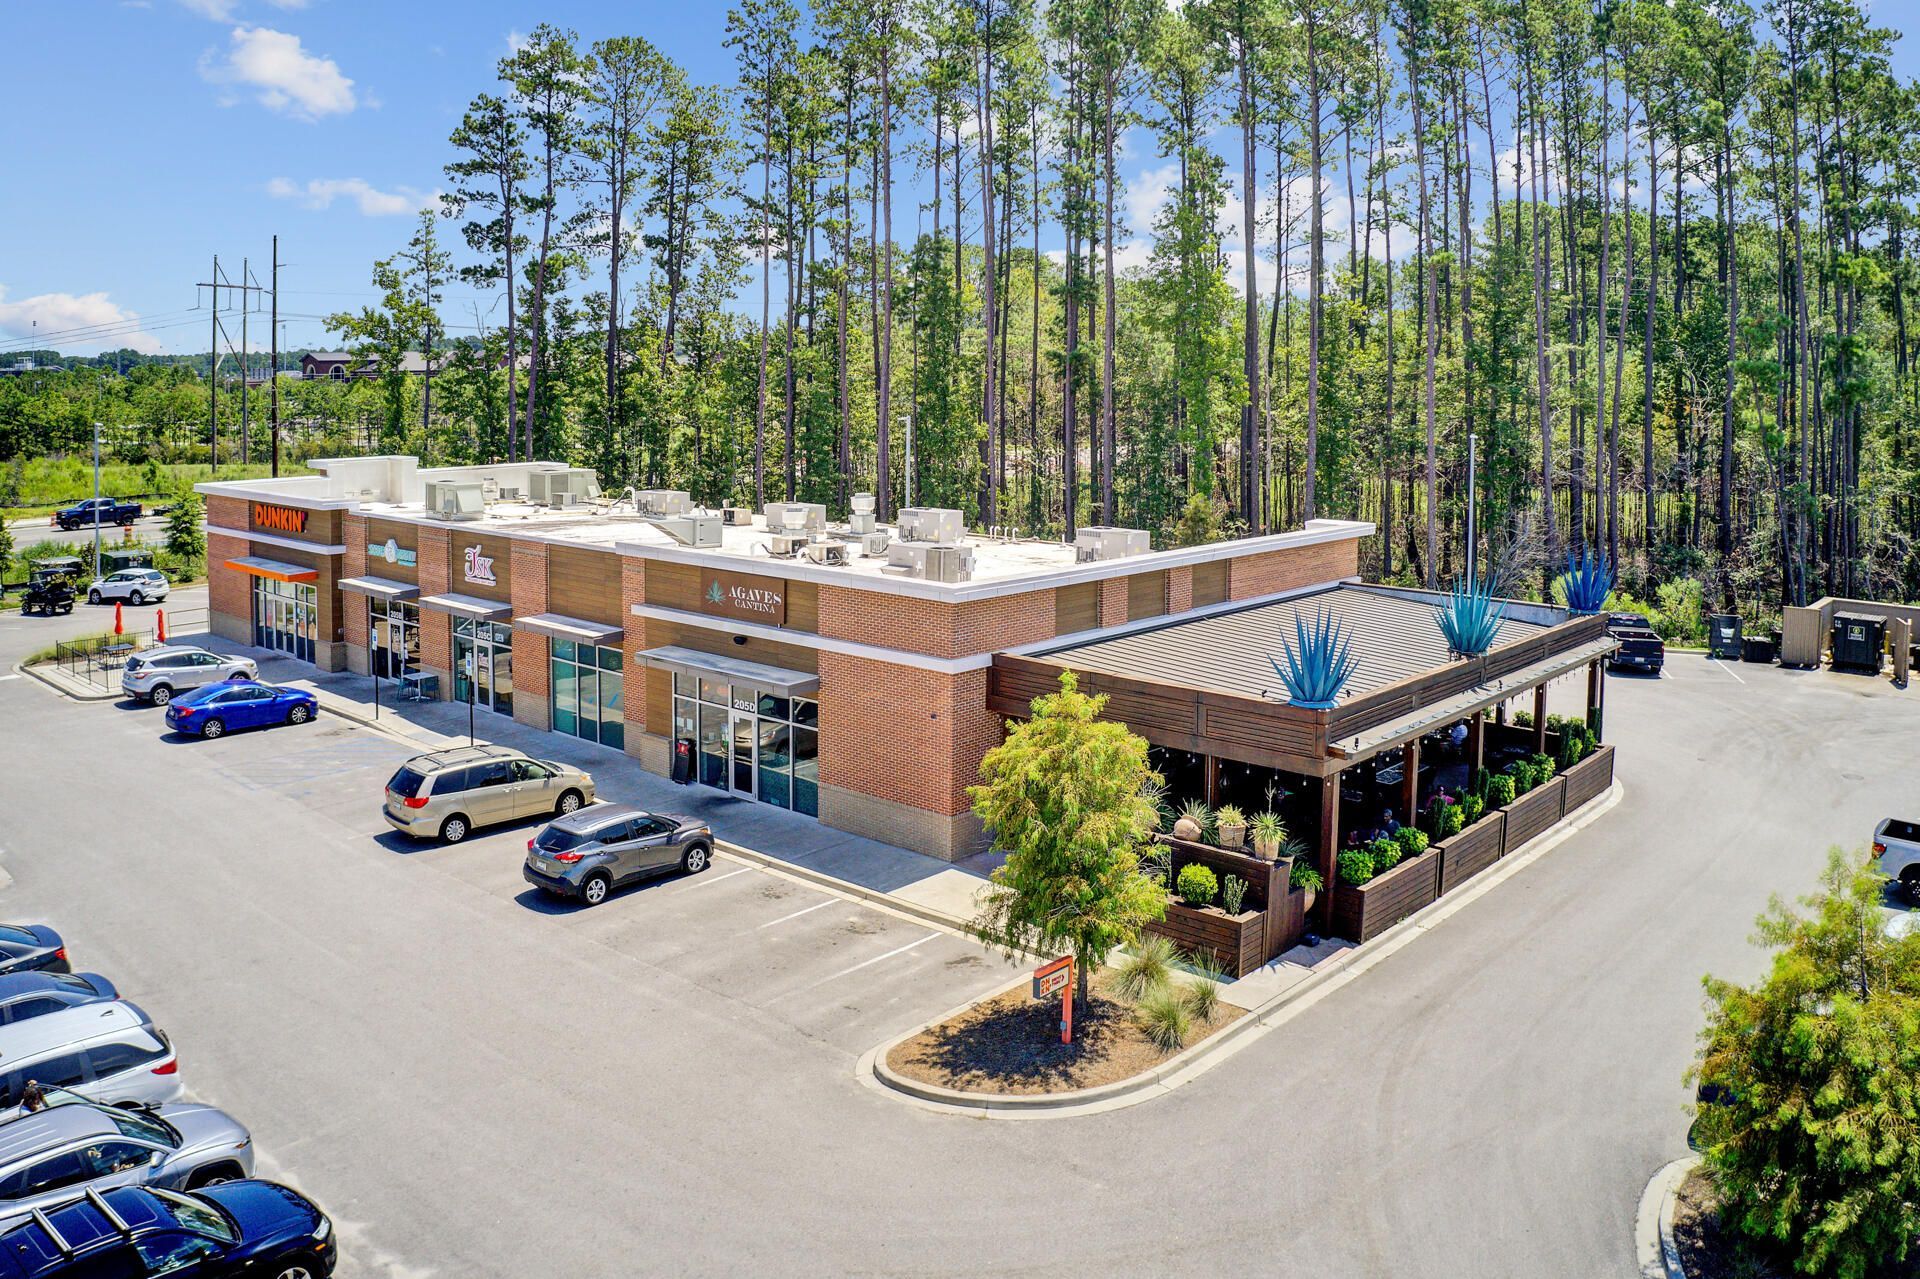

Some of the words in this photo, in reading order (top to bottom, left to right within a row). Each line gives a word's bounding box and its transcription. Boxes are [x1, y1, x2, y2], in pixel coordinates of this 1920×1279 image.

[255, 504, 305, 534] DUNKIN'
[728, 585, 782, 605] AGAVES
[734, 599, 776, 614] CANTINA
[734, 699, 755, 712] 205D
